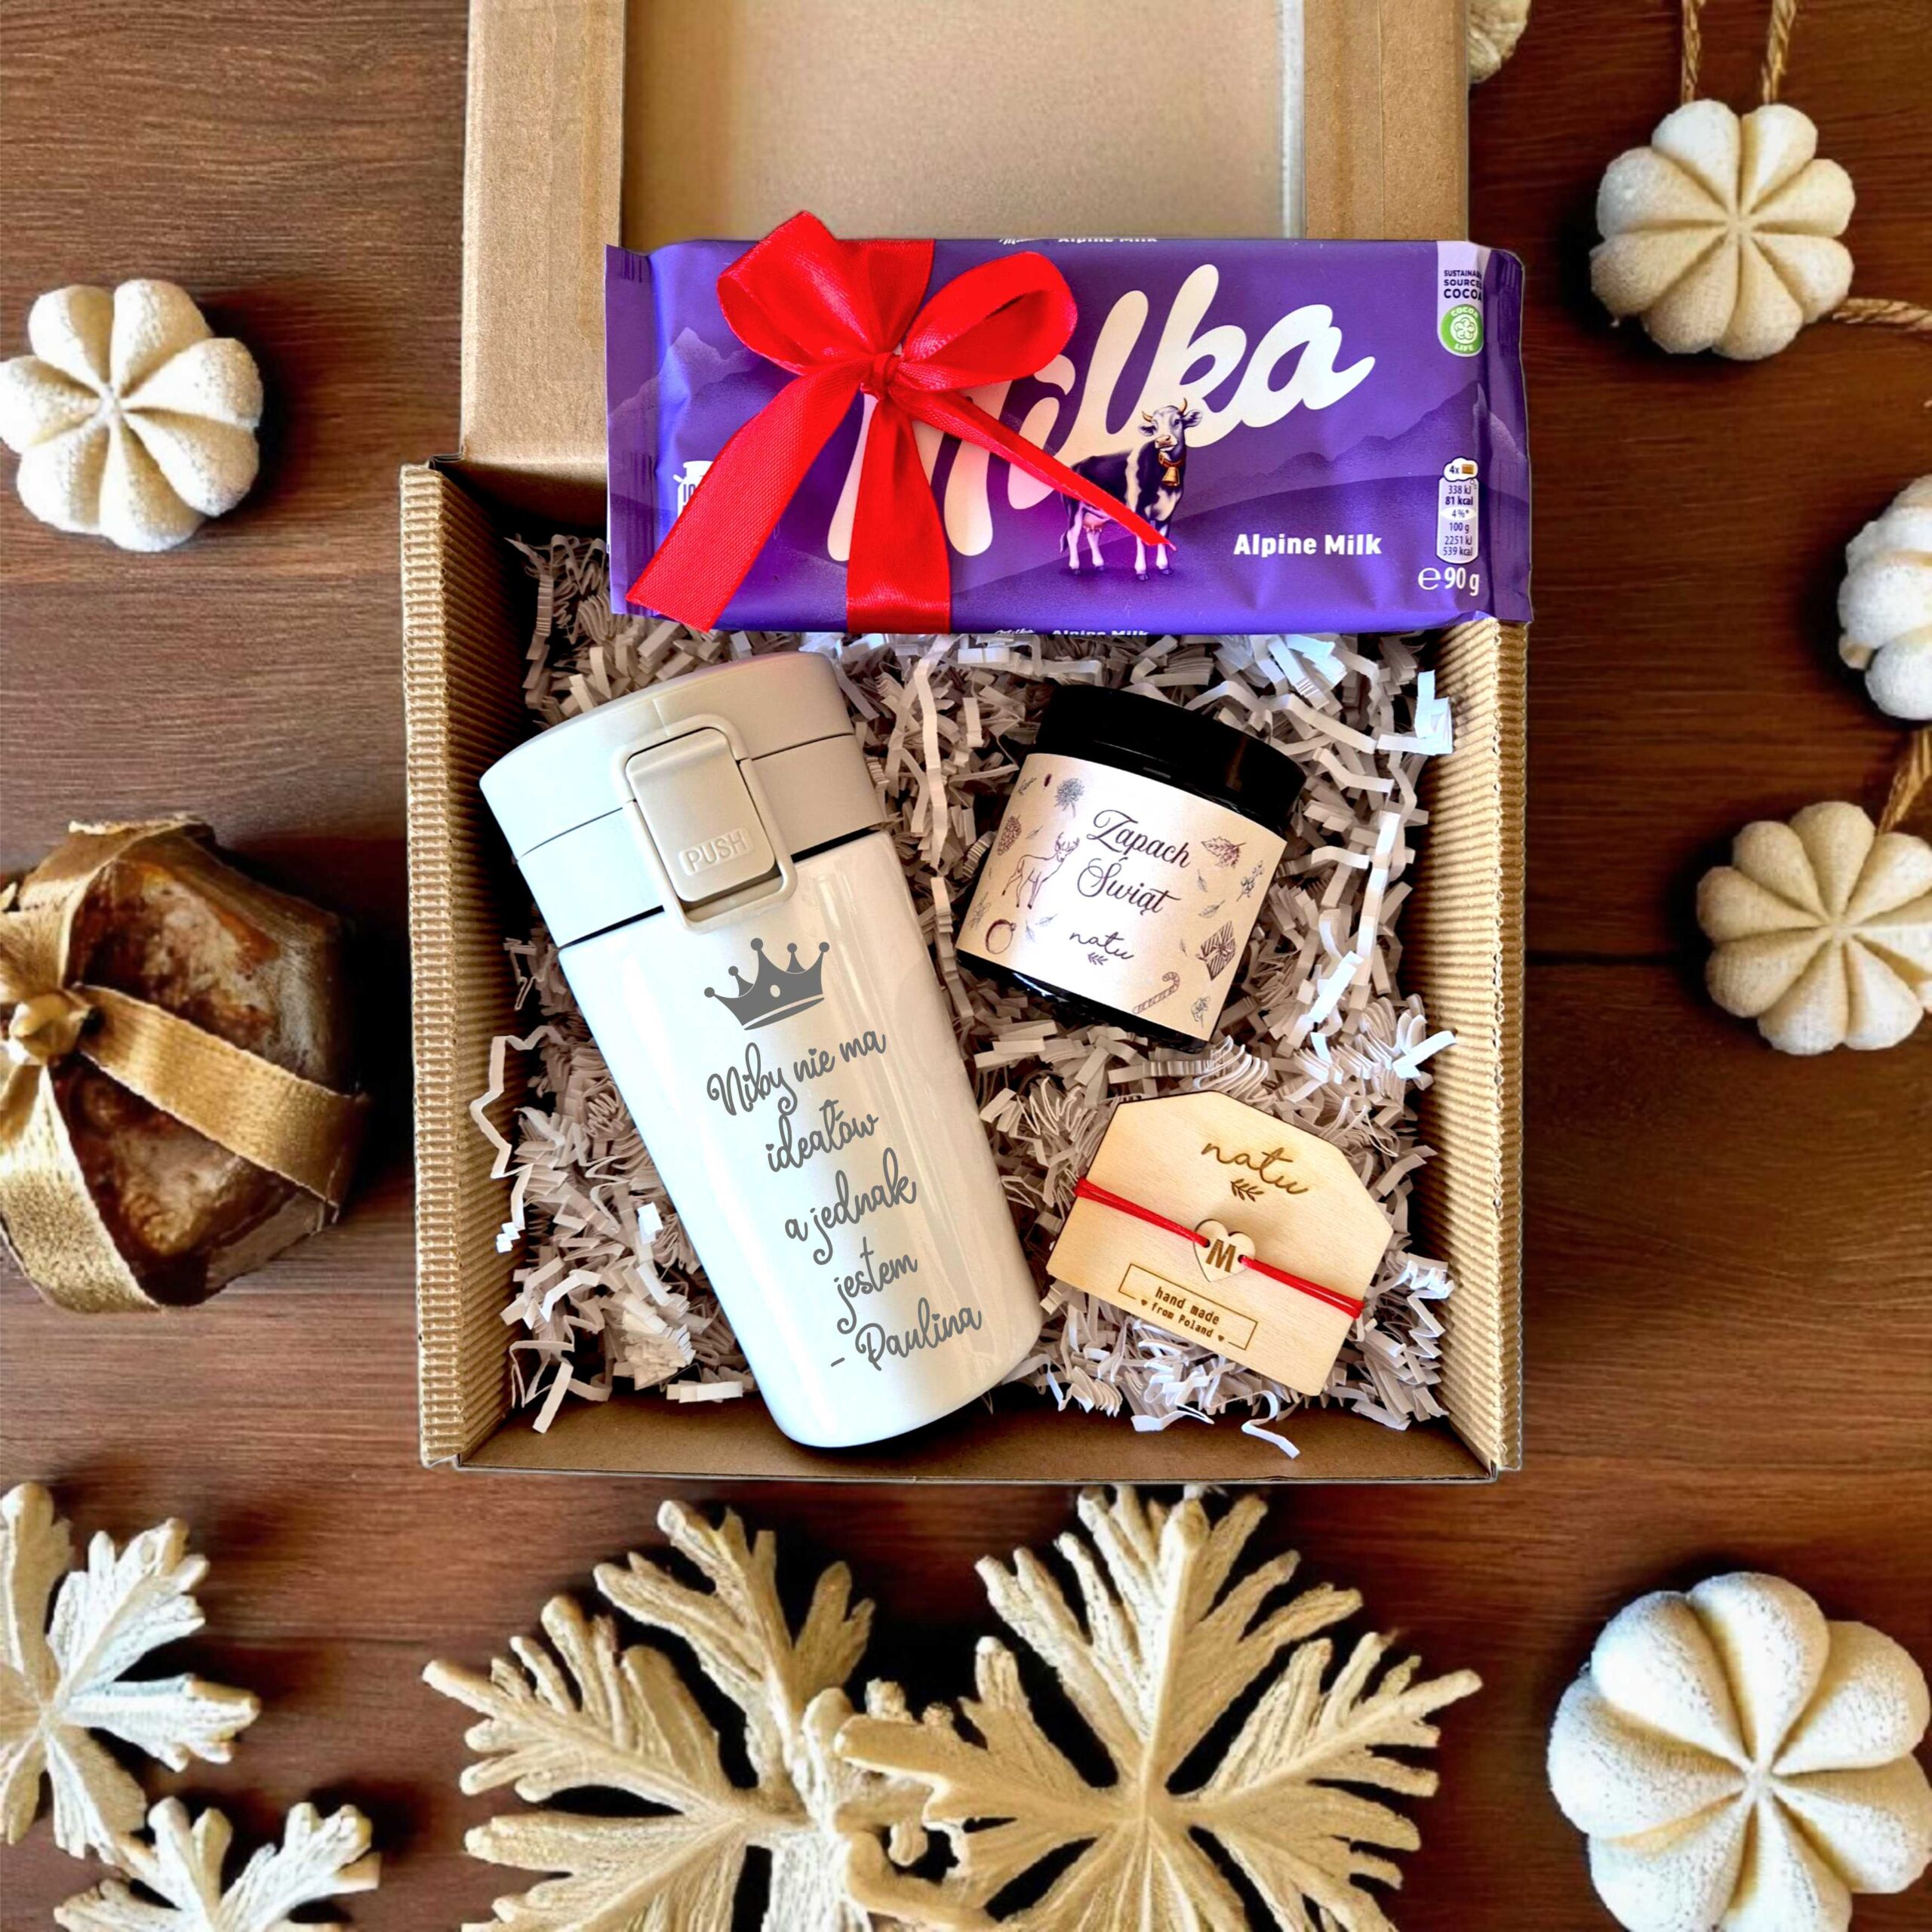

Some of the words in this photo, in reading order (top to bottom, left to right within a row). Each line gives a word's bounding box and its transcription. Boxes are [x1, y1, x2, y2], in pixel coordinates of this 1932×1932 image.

[1451, 306, 1479, 318] COCOA
[1454, 343, 1475, 352] LIFE
[1449, 465, 1460, 474] 4x
[1445, 496, 1455, 505] 81
[1457, 496, 1473, 506] kcal
[1448, 485, 1463, 494] 338
[1444, 536, 1463, 545] 2251
[1449, 522, 1463, 531] 100
[1234, 534, 1319, 558] Alpine
[1325, 533, 1382, 555] Milk
[1443, 547, 1458, 555] 539
[1459, 546, 1473, 556] kcal
[685, 829, 748, 872] PUSH
[1086, 809, 1191, 868] Zapach
[1077, 857, 1181, 915] Świąt
[1069, 931, 1134, 960] natu
[707, 1042, 798, 1115] Niby
[793, 1048, 835, 1082] nie
[839, 1031, 886, 1063] ma
[1201, 1143, 1309, 1195] natu
[785, 1218, 808, 1241] a
[810, 1147, 916, 1265] jednak
[1205, 1238, 1237, 1273] M
[833, 1236, 918, 1334] jestem
[1151, 1303, 1174, 1320] from
[1178, 1314, 1214, 1337] Poland
[1155, 1286, 1184, 1310] hand
[1189, 1302, 1220, 1325] made
[855, 1297, 982, 1371] Paulina
